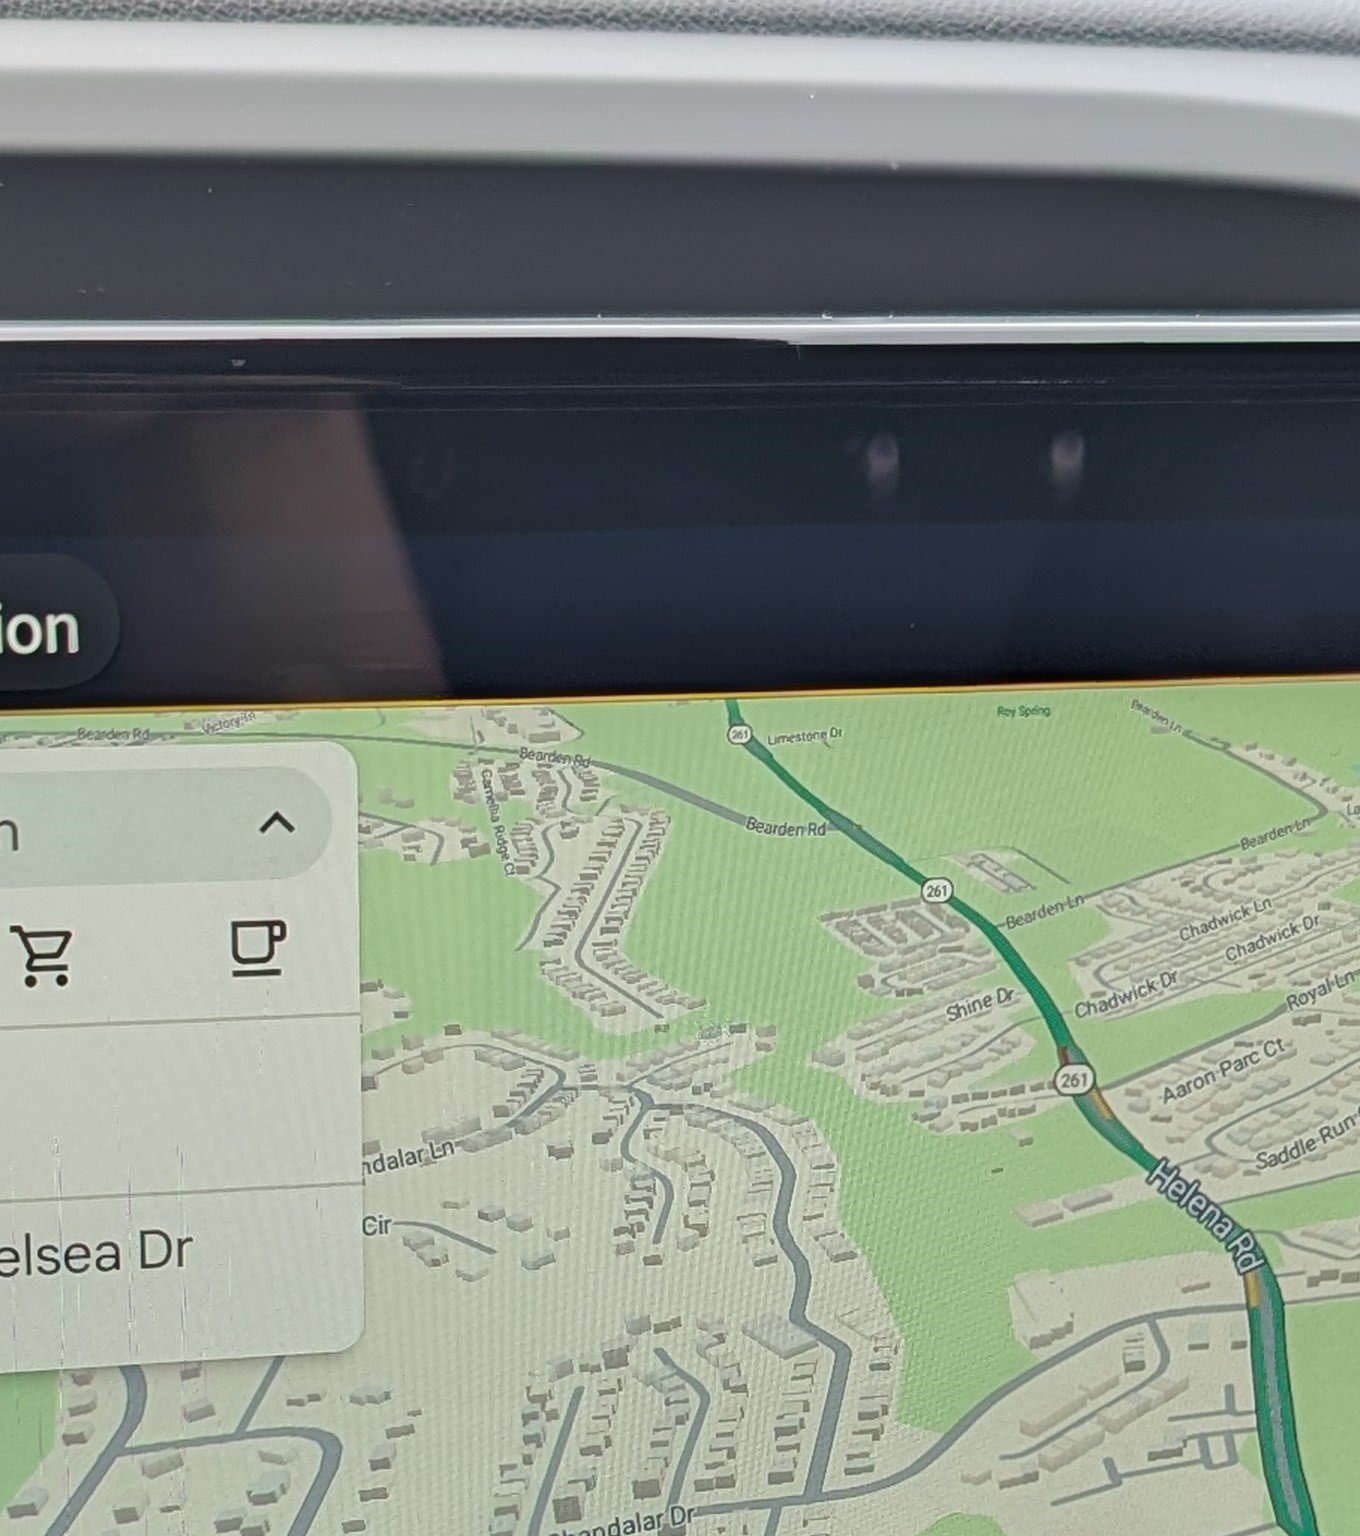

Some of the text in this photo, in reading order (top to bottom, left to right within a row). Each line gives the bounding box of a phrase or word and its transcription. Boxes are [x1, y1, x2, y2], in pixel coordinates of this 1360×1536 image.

[768, 730, 827, 745] Limestone
[520, 746, 591, 768] Bearden Rd
[746, 816, 826, 837] Bearden Rd
[1240, 817, 1311, 850] Bearden Ln
[926, 883, 949, 899] 261
[1006, 893, 1085, 930] Bearden Ln
[1179, 896, 1272, 942] Chadwick Ln
[1226, 914, 1321, 963] Chadwick Dr
[946, 986, 1015, 1022] Shine Dr
[1075, 970, 1178, 1019] Chadwick Dr
[1286, 970, 1356, 1011] Royal Ln
[1059, 1071, 1089, 1088] 261
[1162, 1038, 1286, 1104] Aaron Parc Ct
[429, 1140, 455, 1160] Ln
[1255, 1138, 1317, 1172] Saddle
[1319, 1115, 1354, 1148] Run
[362, 1214, 392, 1237] Cir
[1147, 1158, 1266, 1274] Helena Rd
[140, 1229, 193, 1270] Dr
[669, 1504, 695, 1527] Dr
